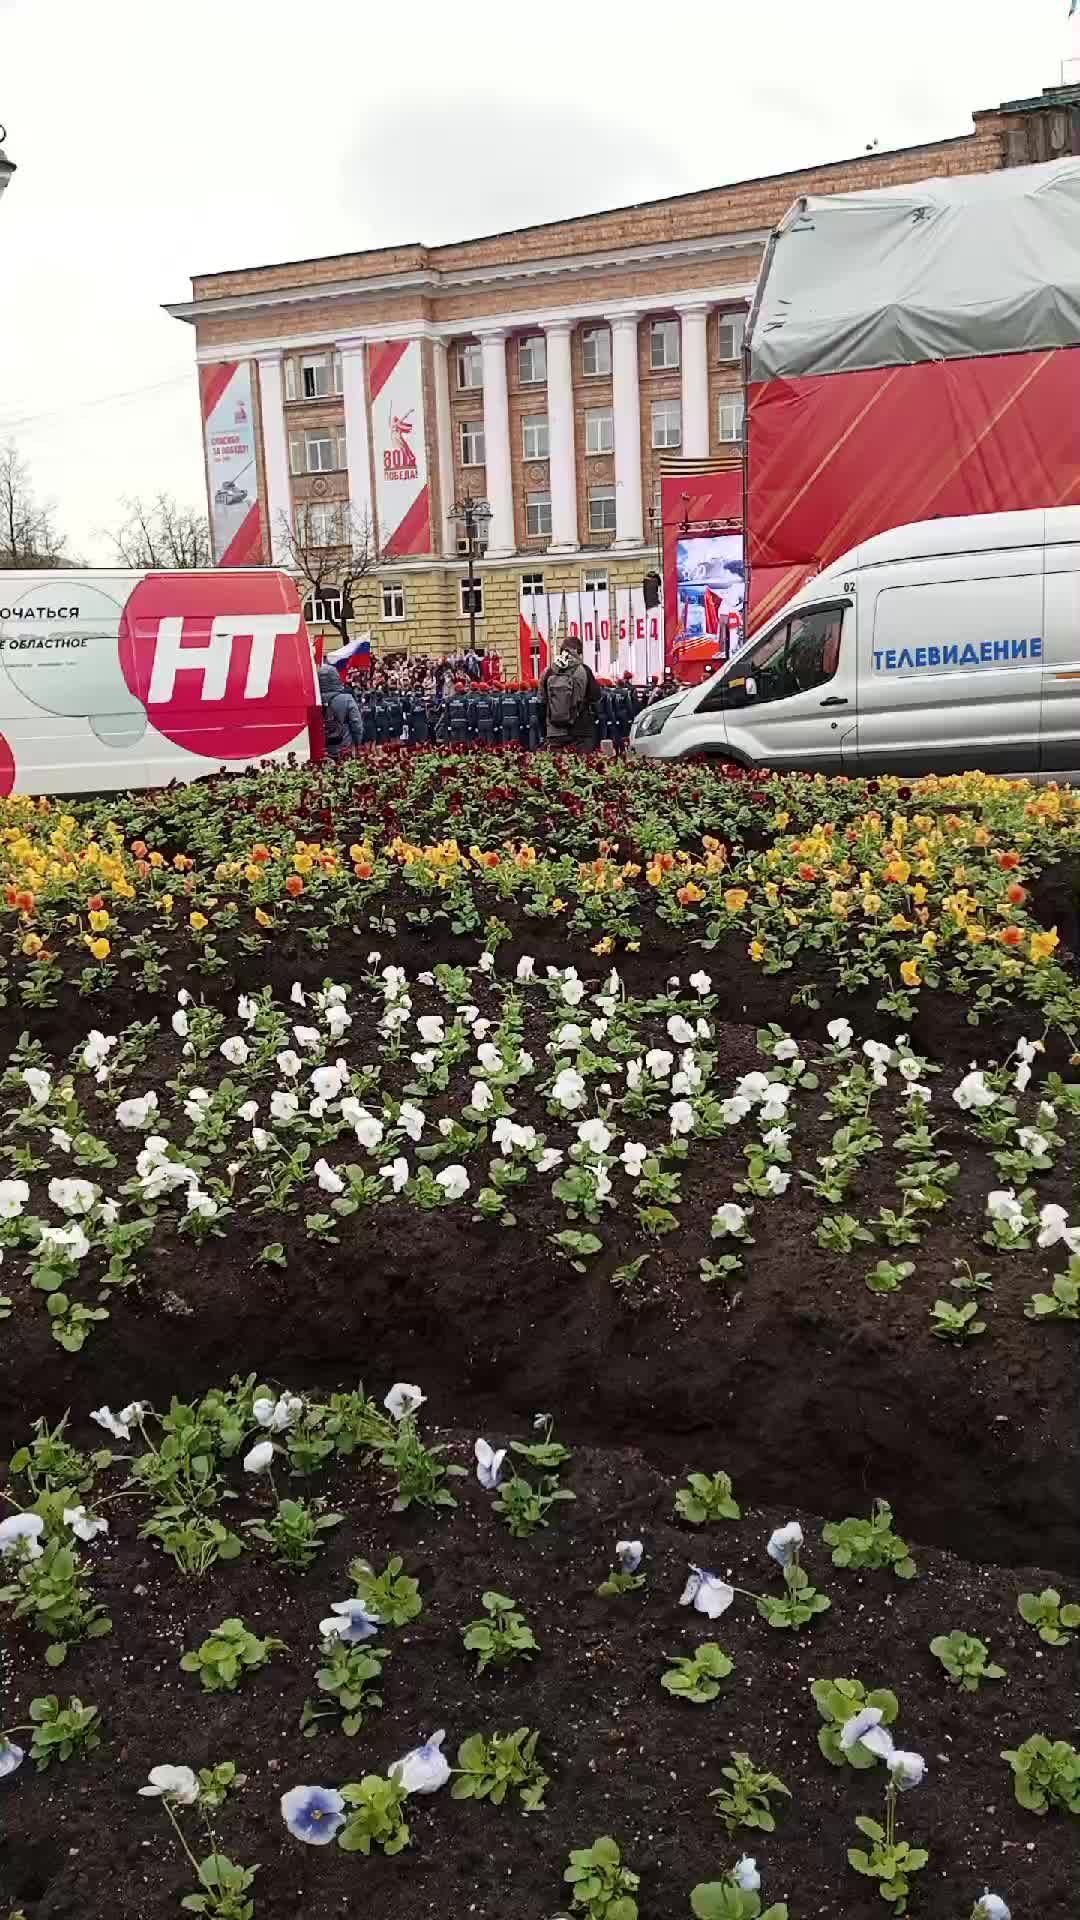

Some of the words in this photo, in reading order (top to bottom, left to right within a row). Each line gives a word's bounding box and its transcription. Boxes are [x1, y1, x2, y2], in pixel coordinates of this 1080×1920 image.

[843, 582, 856, 592] 02
[9, 638, 89, 650] ОБЛАСТНОЕ
[873, 637, 1043, 671] ТЕЛЕВИДЕНИЕ
[147, 613, 301, 704] НТ
